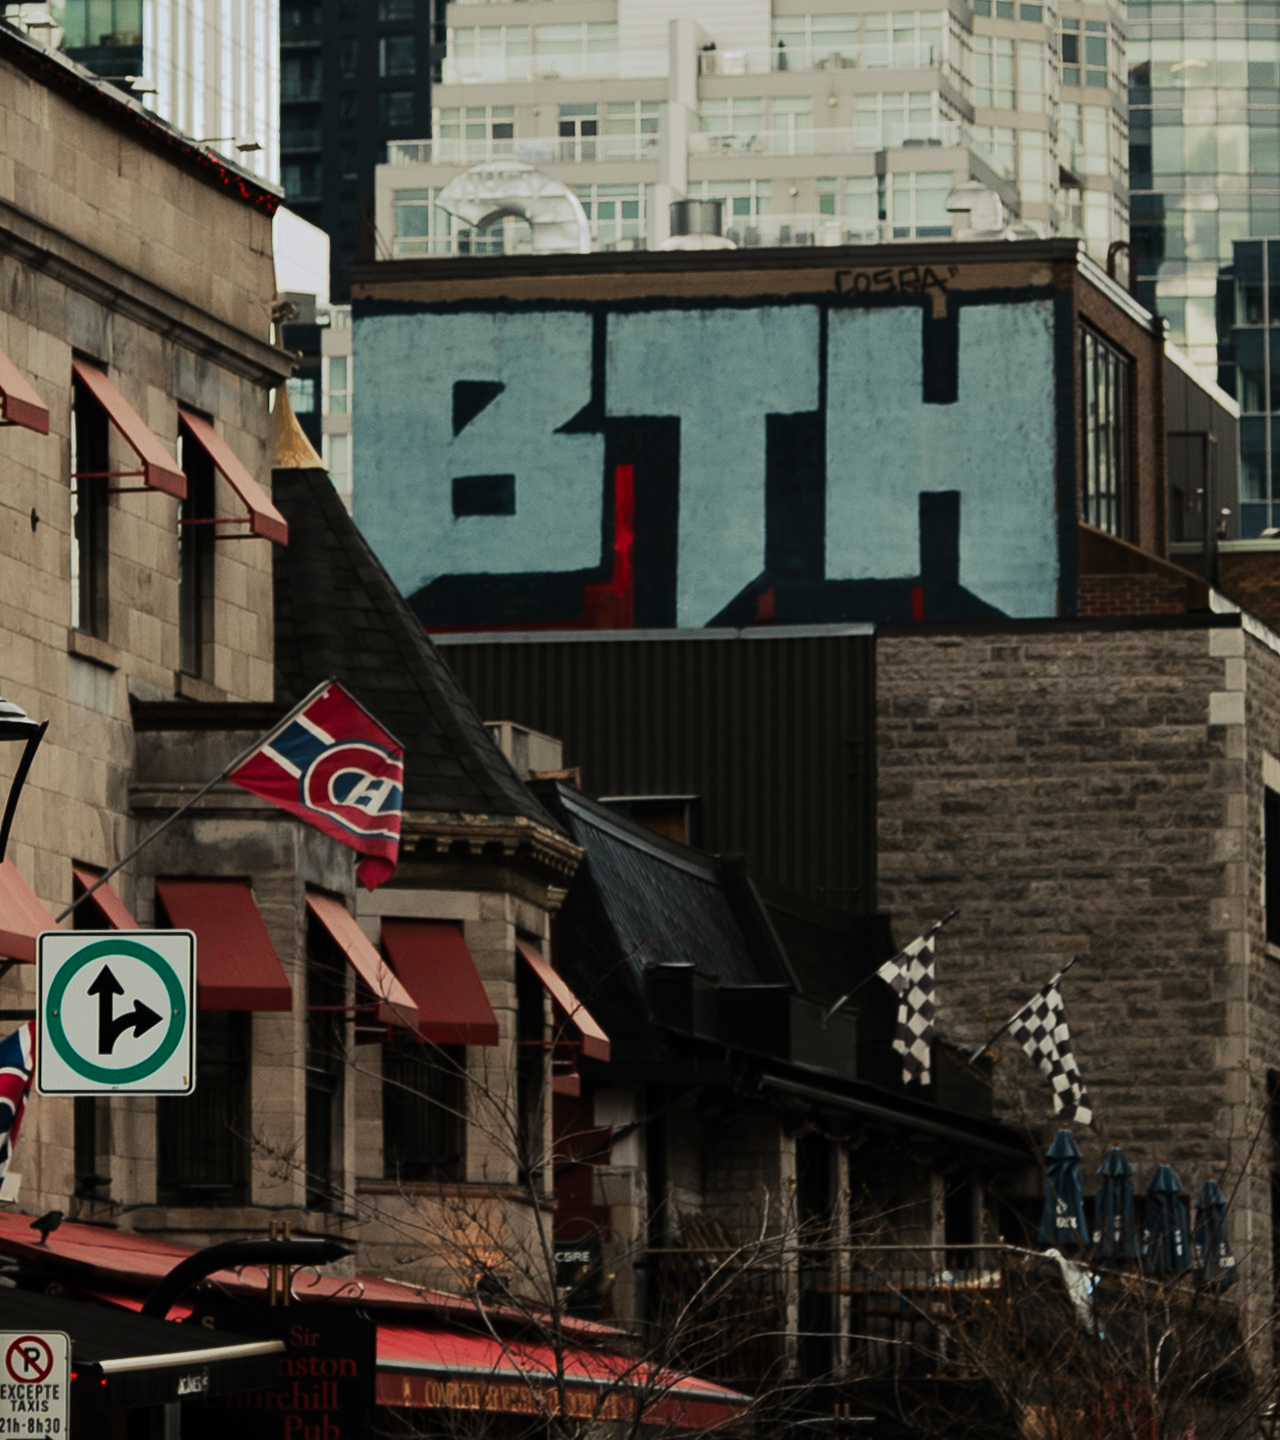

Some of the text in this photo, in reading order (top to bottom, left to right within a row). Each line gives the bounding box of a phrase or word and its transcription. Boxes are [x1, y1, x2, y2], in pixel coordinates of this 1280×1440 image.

[352, 301, 1060, 627] BTH
[289, 1325, 320, 1348] Sir
[0, 1384, 60, 1400] EXCEPTE
[10, 1400, 49, 1412] TAXIS
